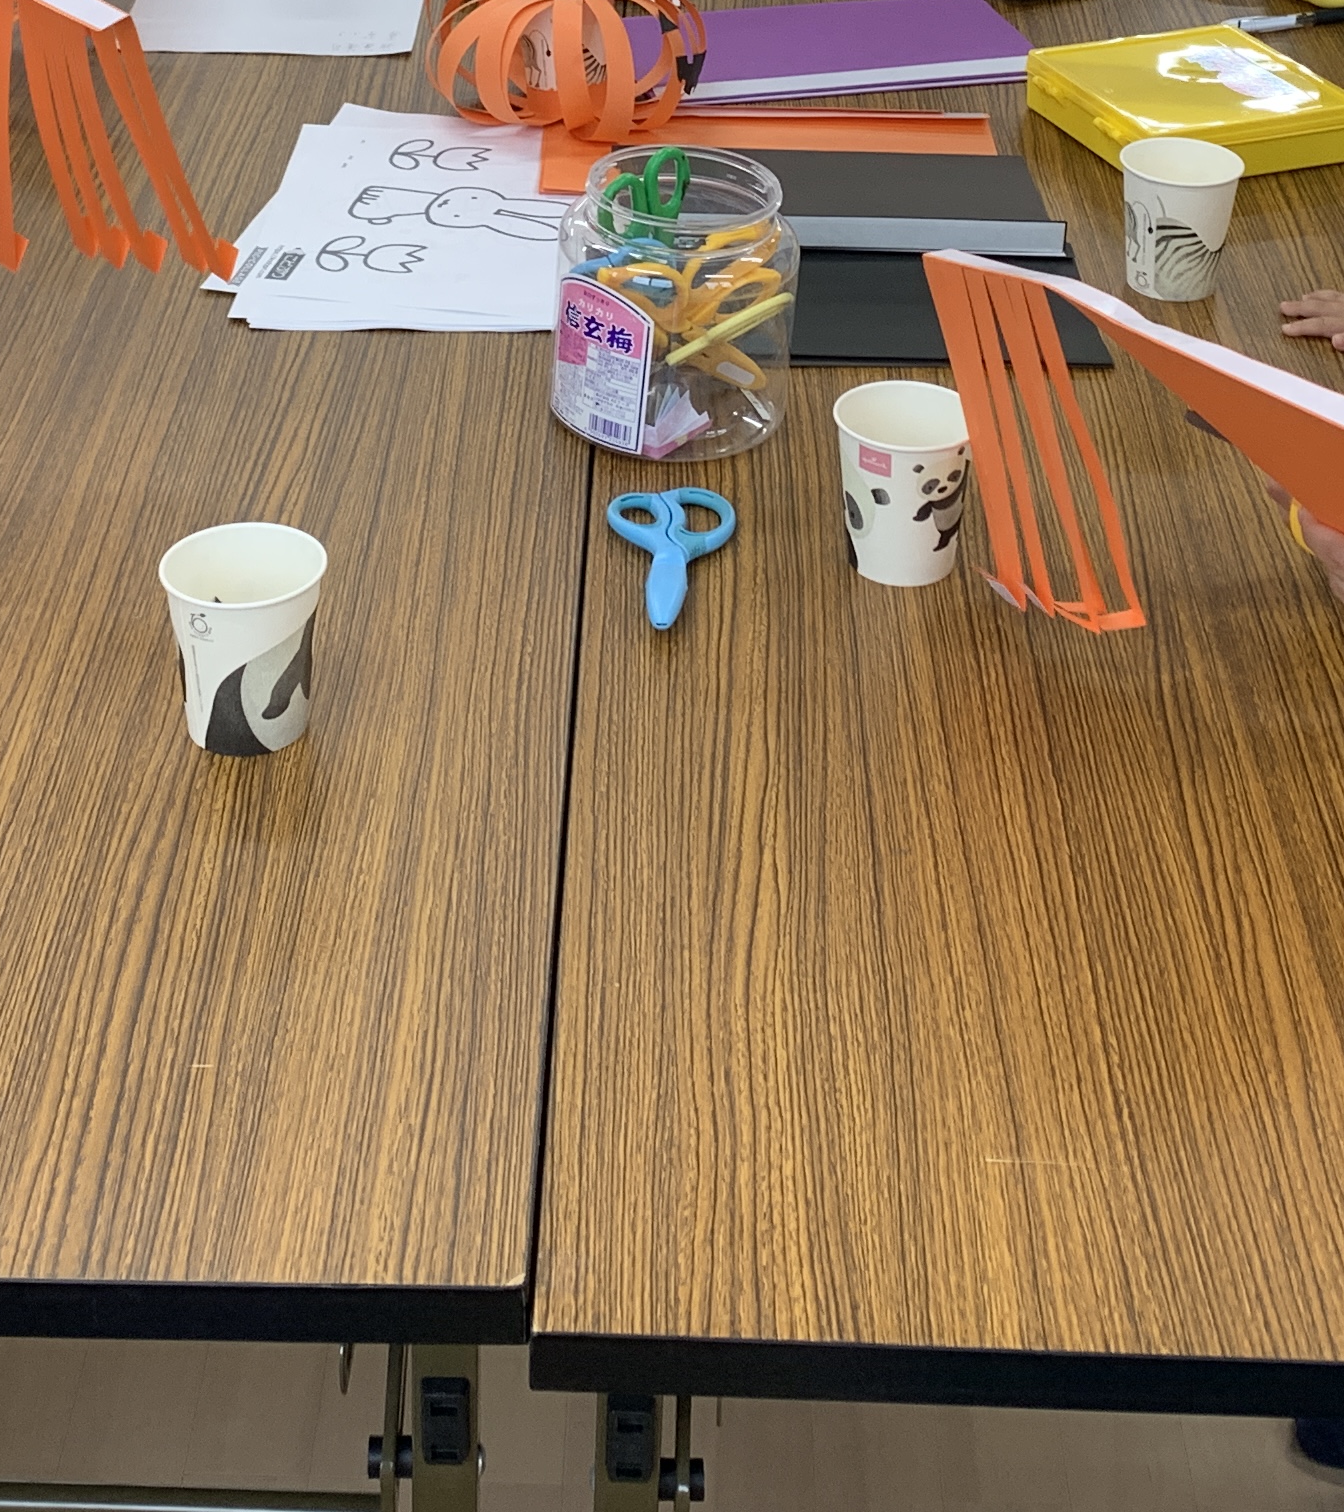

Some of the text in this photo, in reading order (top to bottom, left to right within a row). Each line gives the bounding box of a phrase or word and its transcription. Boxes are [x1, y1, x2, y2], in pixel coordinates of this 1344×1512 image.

[565, 300, 634, 354] 信玄梅
[577, 297, 614, 321] カリカリ
